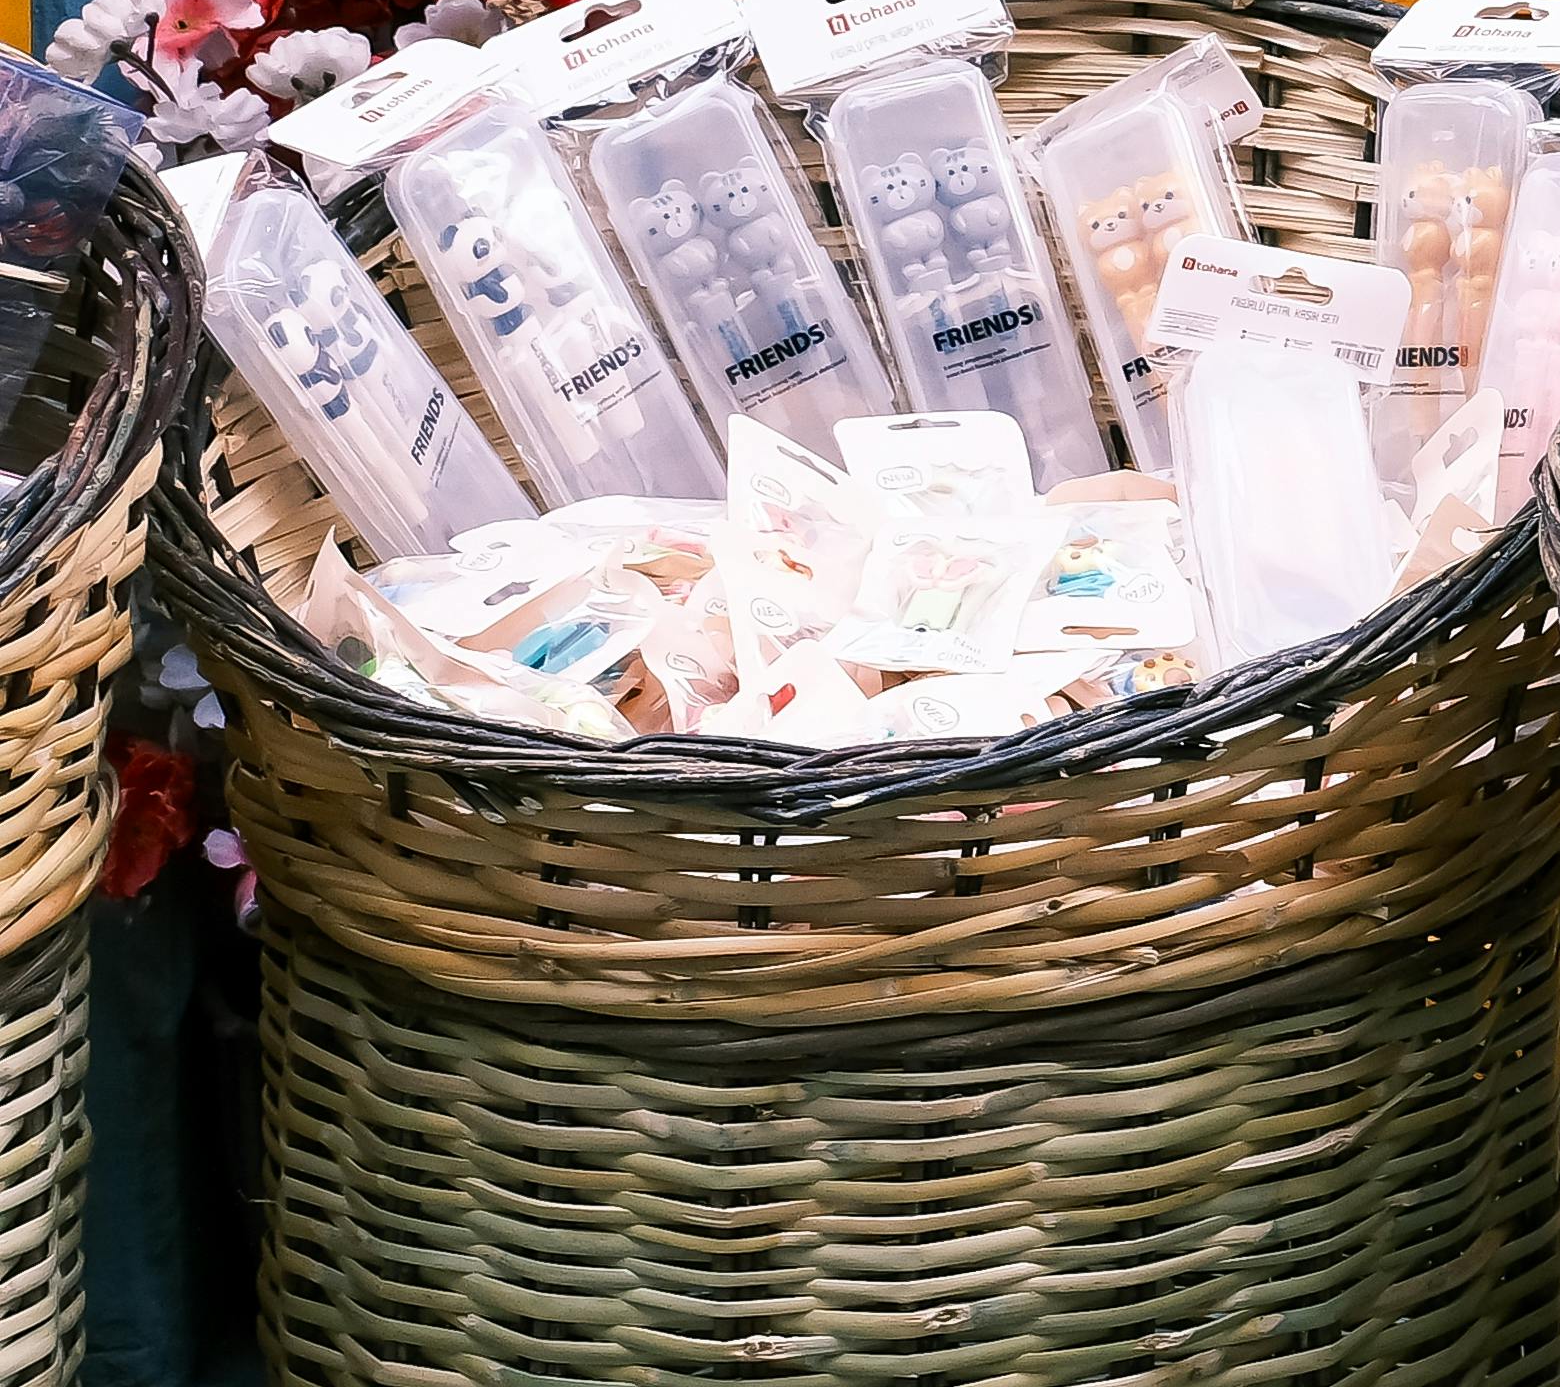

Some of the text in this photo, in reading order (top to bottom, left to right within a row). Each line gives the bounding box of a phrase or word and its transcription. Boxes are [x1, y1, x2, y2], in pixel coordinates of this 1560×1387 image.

[588, 22, 656, 59] tohana
[1474, 27, 1533, 39] tohana
[377, 78, 434, 114] tohana
[1196, 261, 1239, 278] tohana
[932, 303, 1035, 352] FRIENDS
[559, 335, 642, 402] FRIENDS
[725, 322, 825, 385] FRIENDS
[410, 387, 446, 466] FRIENDS
